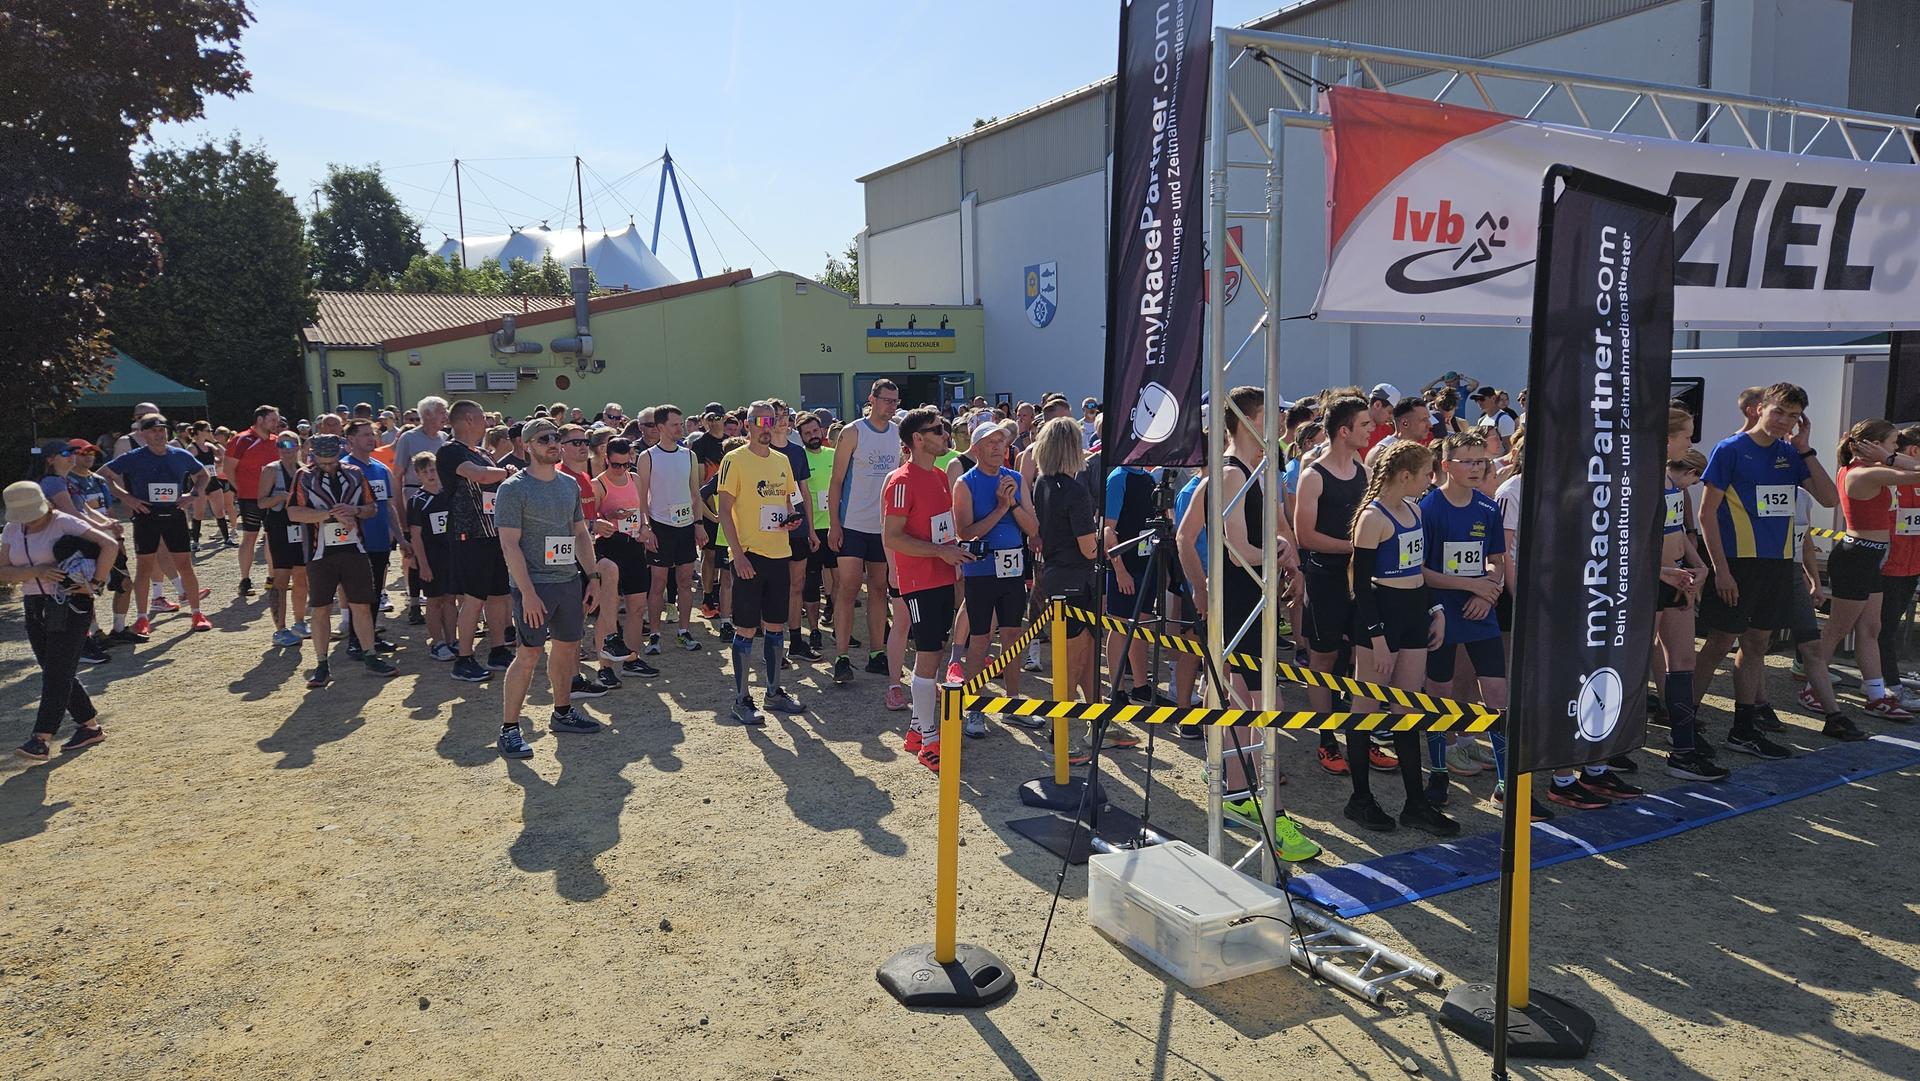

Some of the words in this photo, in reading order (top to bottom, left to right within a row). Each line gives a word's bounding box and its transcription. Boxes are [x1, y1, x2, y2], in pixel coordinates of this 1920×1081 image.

[1140, 2, 1170, 365] myRacePartner.com
[1392, 196, 1465, 244] lvb
[1667, 171, 1875, 291] ZIEL
[1159, 333, 1168, 364] Dein
[1168, 181, 1182, 210] und
[1618, 231, 1631, 429] Zeitnahmedienstleister
[820, 343, 833, 353] 3a
[332, 368, 345, 378] 3b
[1583, 225, 1617, 647] myRacePartner.com
[1620, 434, 1631, 466] und
[154, 487, 174, 496] 229
[1763, 493, 1788, 505] 152
[771, 512, 784, 523] 38
[552, 543, 572, 554] 165
[1616, 470, 1632, 605] Veranstaltungs-
[1003, 553, 1019, 568] 51
[1453, 550, 1480, 564] 182
[1614, 609, 1627, 647] Dein
